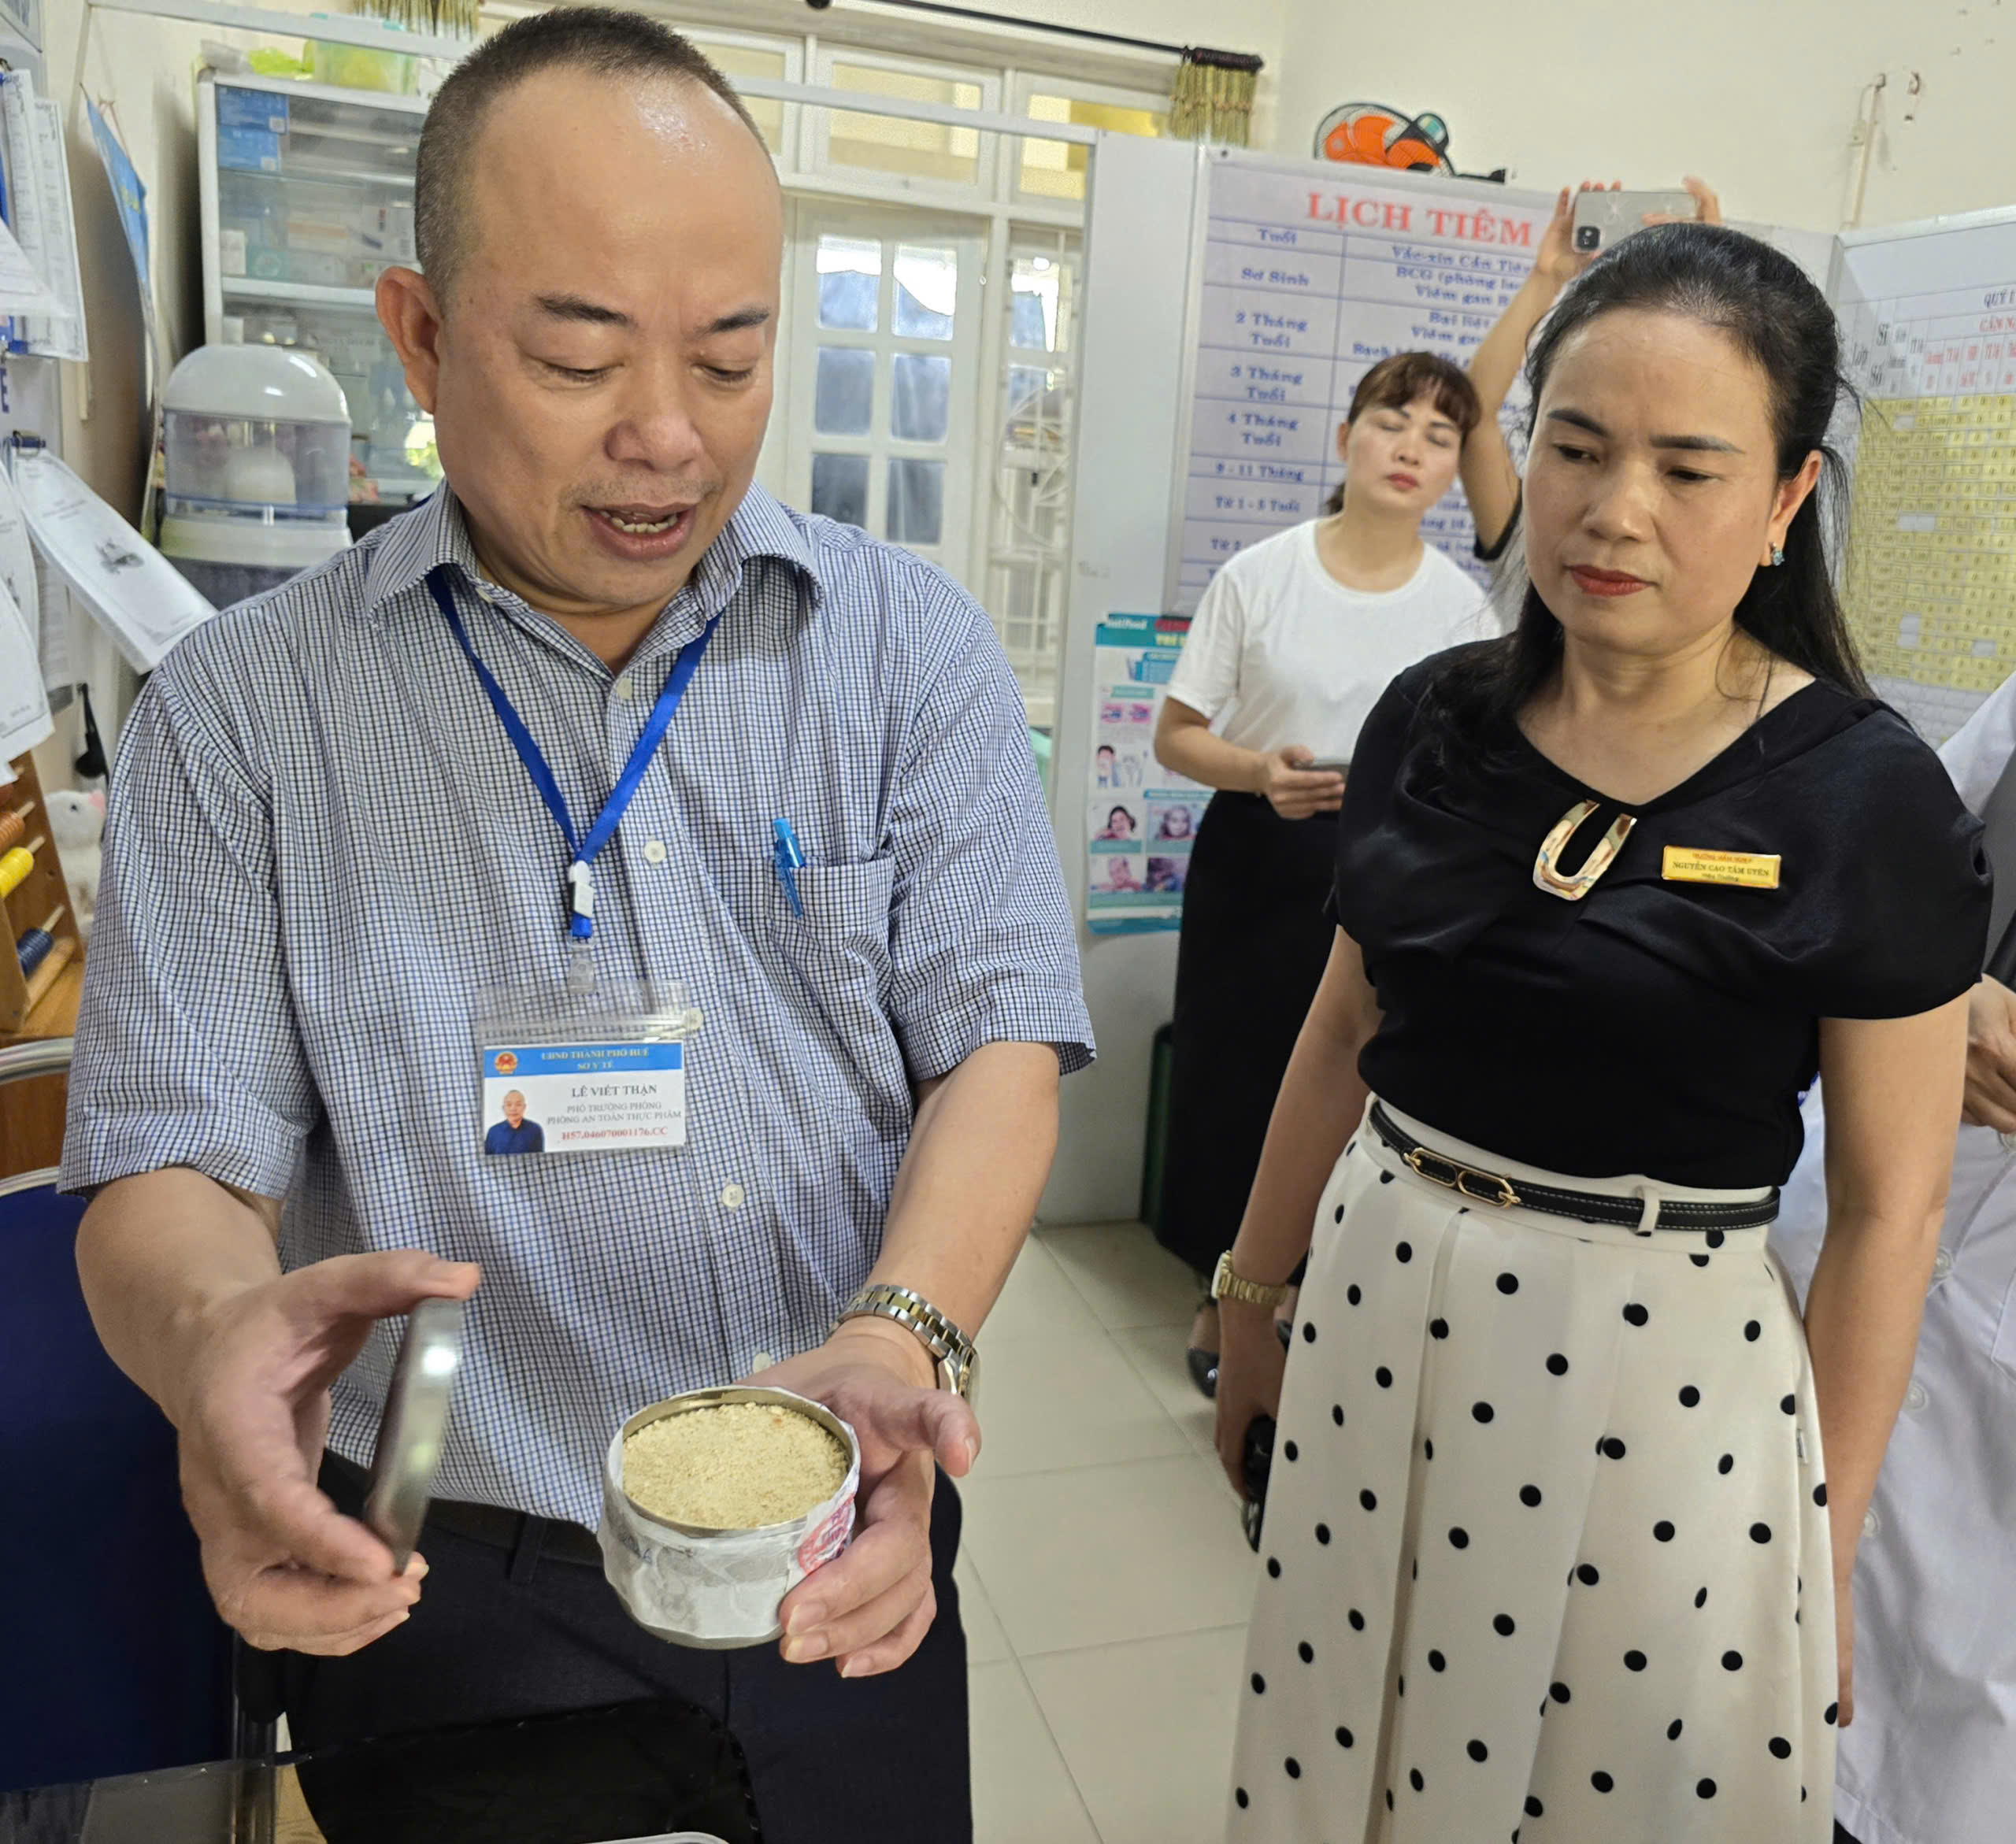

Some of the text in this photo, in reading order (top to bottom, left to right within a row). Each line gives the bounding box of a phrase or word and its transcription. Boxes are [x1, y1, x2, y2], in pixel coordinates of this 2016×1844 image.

[1306, 191, 1532, 246] LỊCH TIÊM
[572, 1084, 588, 1098] LÊ
[582, 1115, 596, 1124] AN
